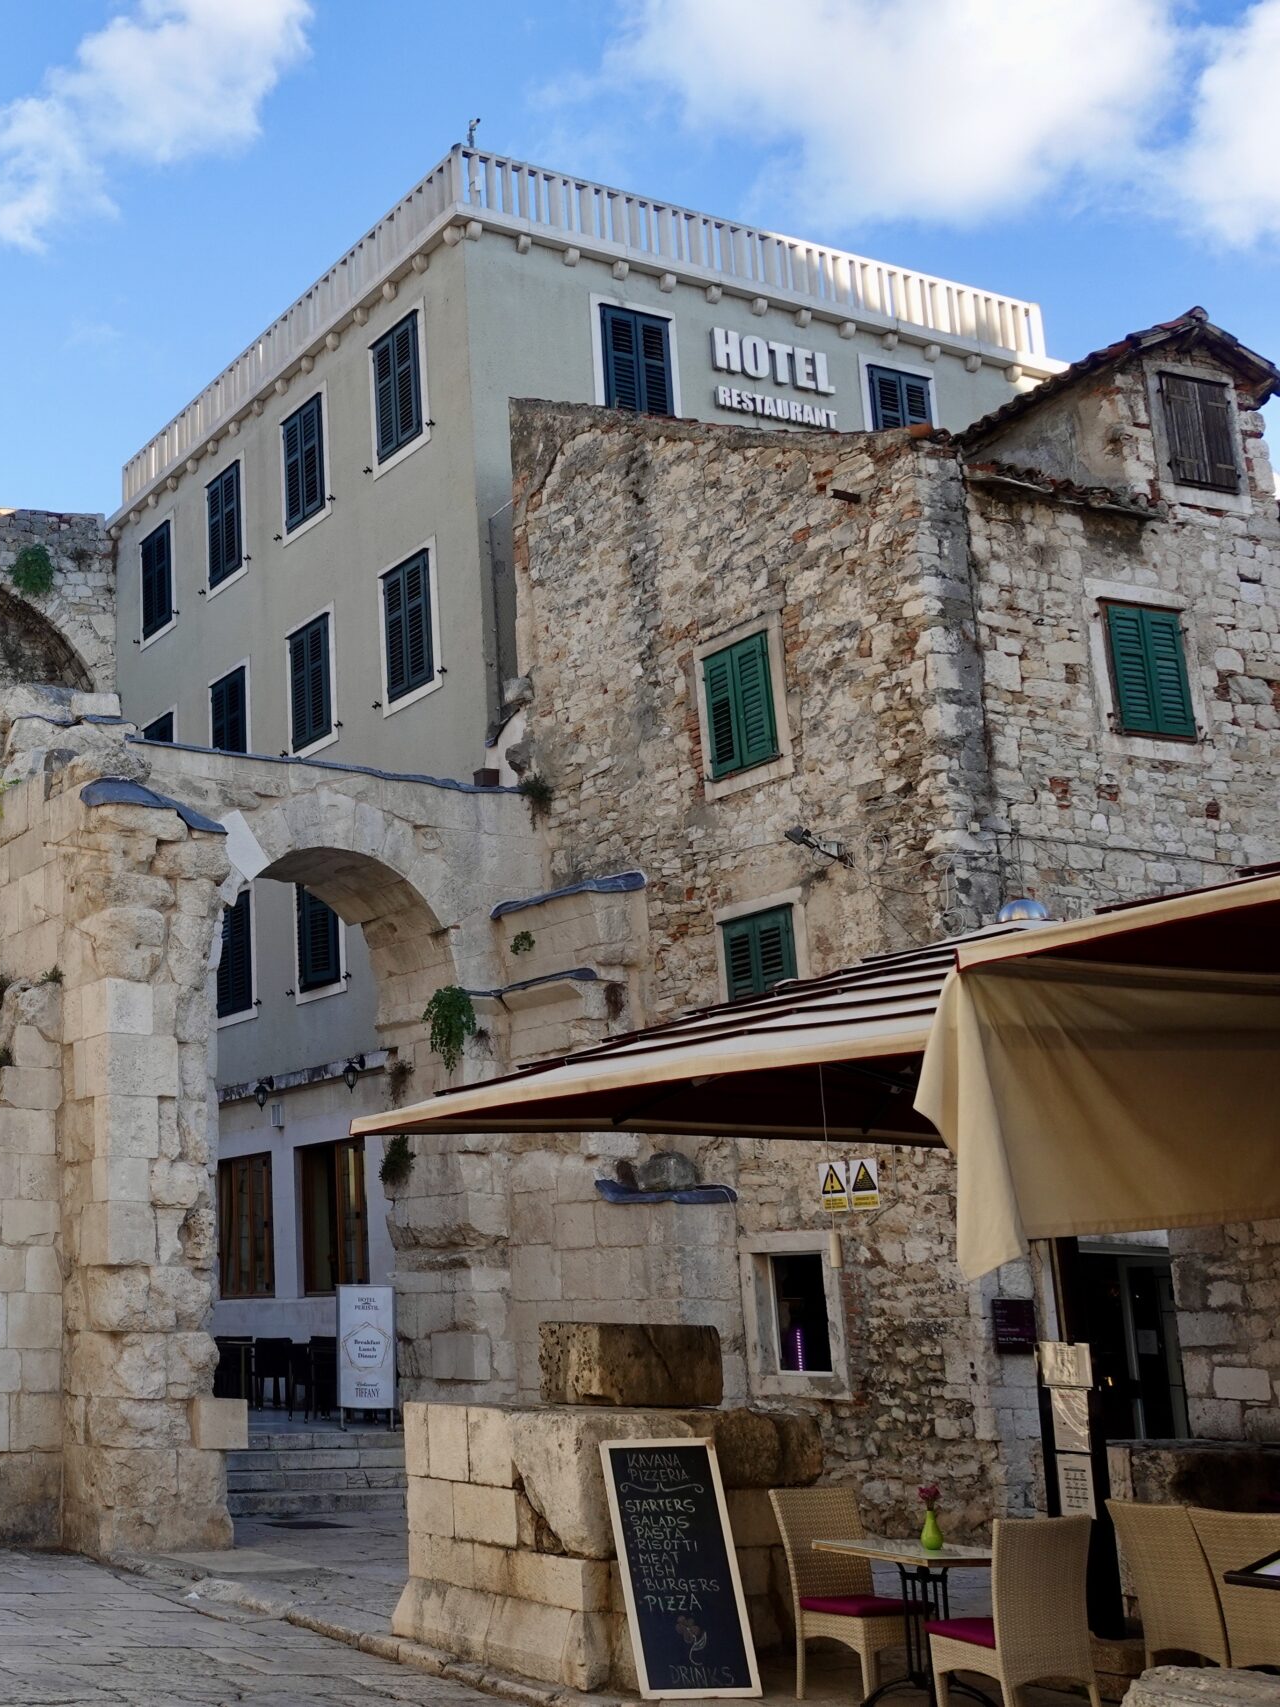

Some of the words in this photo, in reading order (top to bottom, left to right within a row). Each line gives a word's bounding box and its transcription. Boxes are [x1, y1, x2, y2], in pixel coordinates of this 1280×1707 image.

[710, 327, 836, 395] HOTEL
[714, 385, 838, 429] RESTAURANT
[355, 1388, 380, 1398] TIFFANY
[626, 1453, 682, 1468] KAVANA
[628, 1468, 690, 1482] PIZZERIA
[624, 1499, 696, 1513] STARTERS
[630, 1515, 690, 1529] SALADS
[634, 1527, 686, 1540] PASTA
[634, 1539, 698, 1552] RISOTTI
[639, 1551, 680, 1564] MEAT
[639, 1564, 676, 1577] FISH
[643, 1578, 720, 1592] BURGERS
[643, 1594, 703, 1611] PIZZA
[669, 1664, 735, 1686] DRINKS
